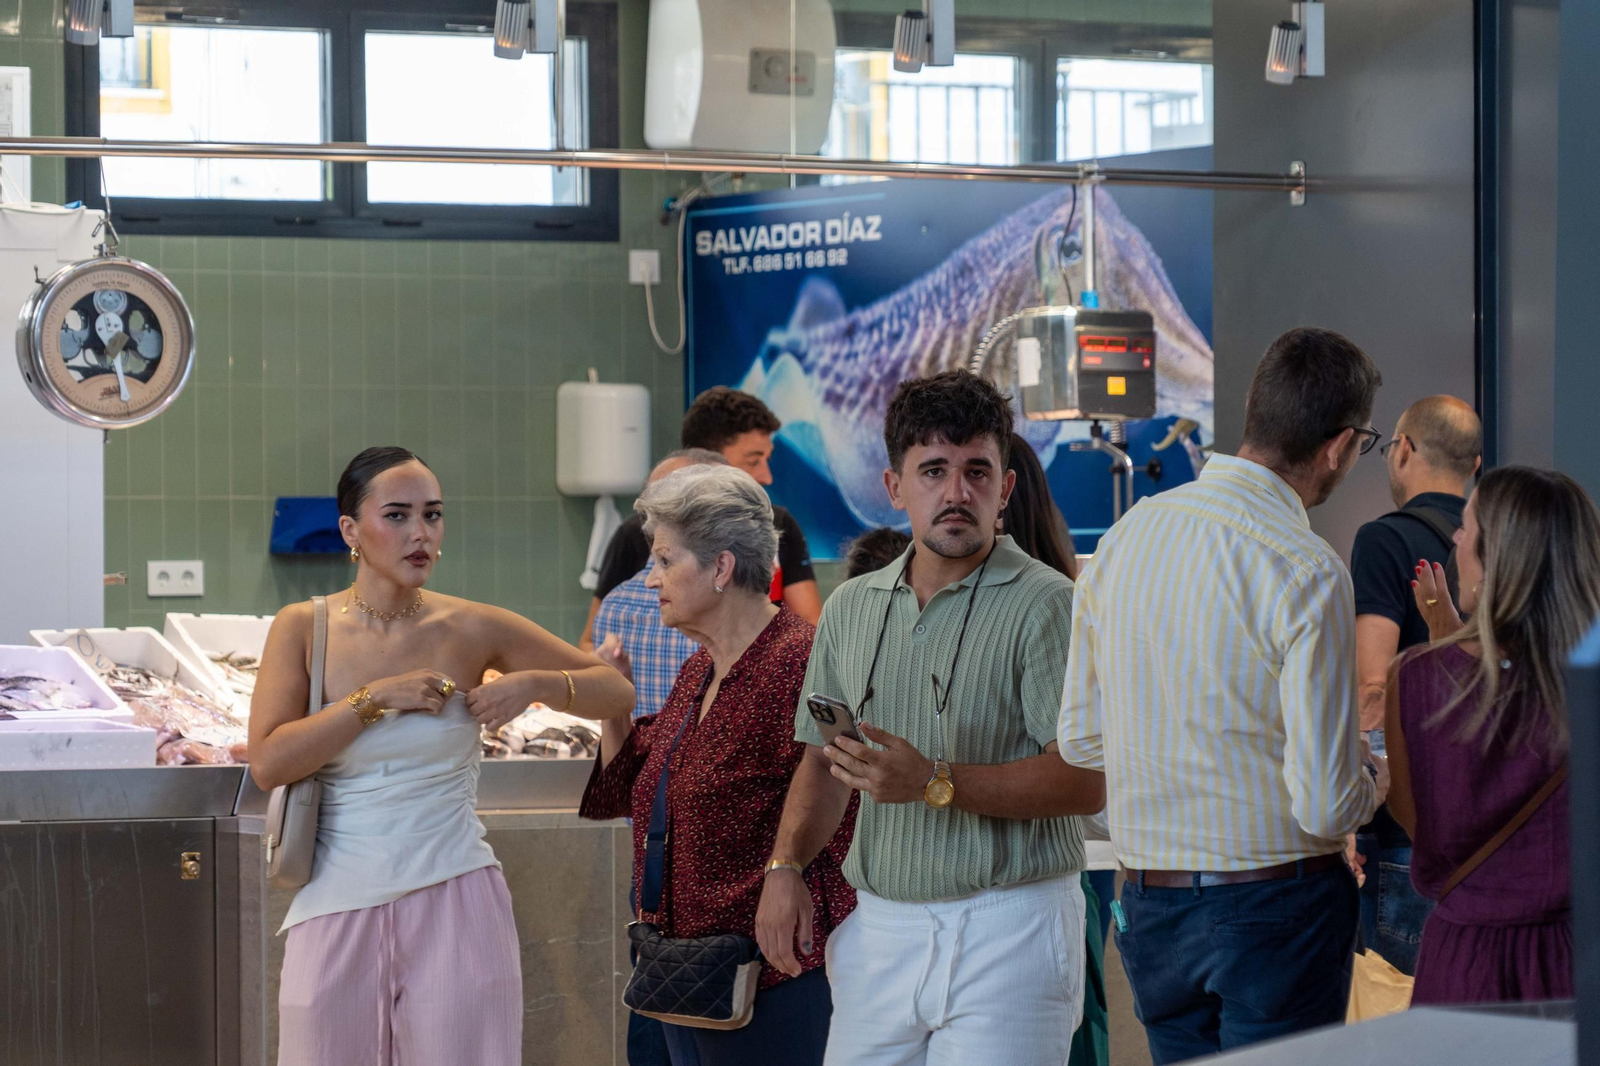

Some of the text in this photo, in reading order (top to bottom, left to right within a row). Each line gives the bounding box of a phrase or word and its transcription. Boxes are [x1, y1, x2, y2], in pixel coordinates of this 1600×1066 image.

[695, 211, 882, 256] SALVADOR DÍAZ
[783, 251, 802, 271] 51
[827, 248, 848, 267] 92
